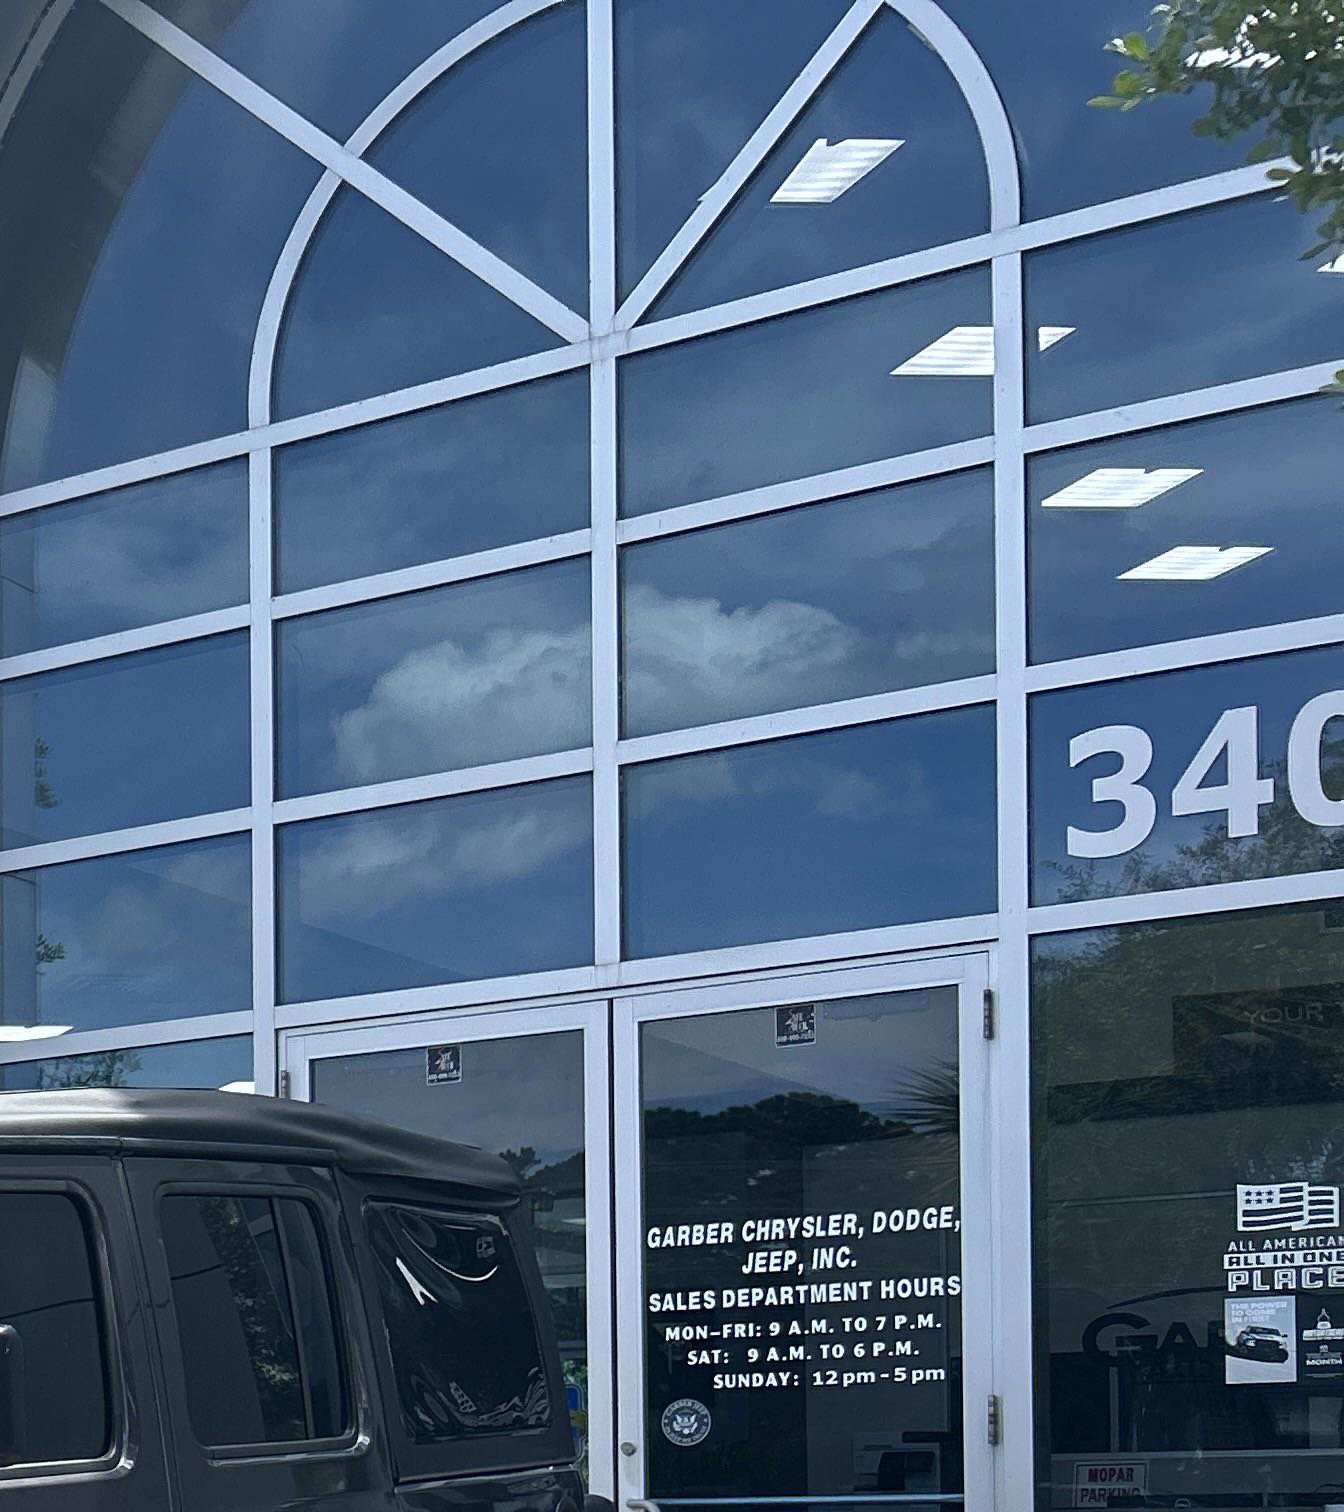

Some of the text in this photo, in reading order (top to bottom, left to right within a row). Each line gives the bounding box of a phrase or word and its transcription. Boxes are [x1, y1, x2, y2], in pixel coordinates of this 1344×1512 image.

[647, 1206, 961, 1249] GARBER CHRYSLER, DODGE,
[1228, 1239, 1256, 1252] ALL
[741, 1246, 857, 1275] JEEP, INC.
[1228, 1250, 1344, 1267] ALL IN ONE
[1227, 1266, 1344, 1292] PLACE
[648, 1275, 961, 1312] SALES DEPARTMENT HOURS
[664, 1313, 942, 1341] MON-FRI: 9 A.M. TO 7 P.M.
[687, 1340, 920, 1365] SAT: 9 A.M. TO 6 P.M.
[713, 1371, 800, 1389] SUNDAY:
[812, 1370, 838, 1386] 12
[842, 1371, 876, 1387] pm
[893, 1367, 910, 1383] 5
[912, 1367, 946, 1385] pm
[1087, 1467, 1135, 1482] MOPAR
